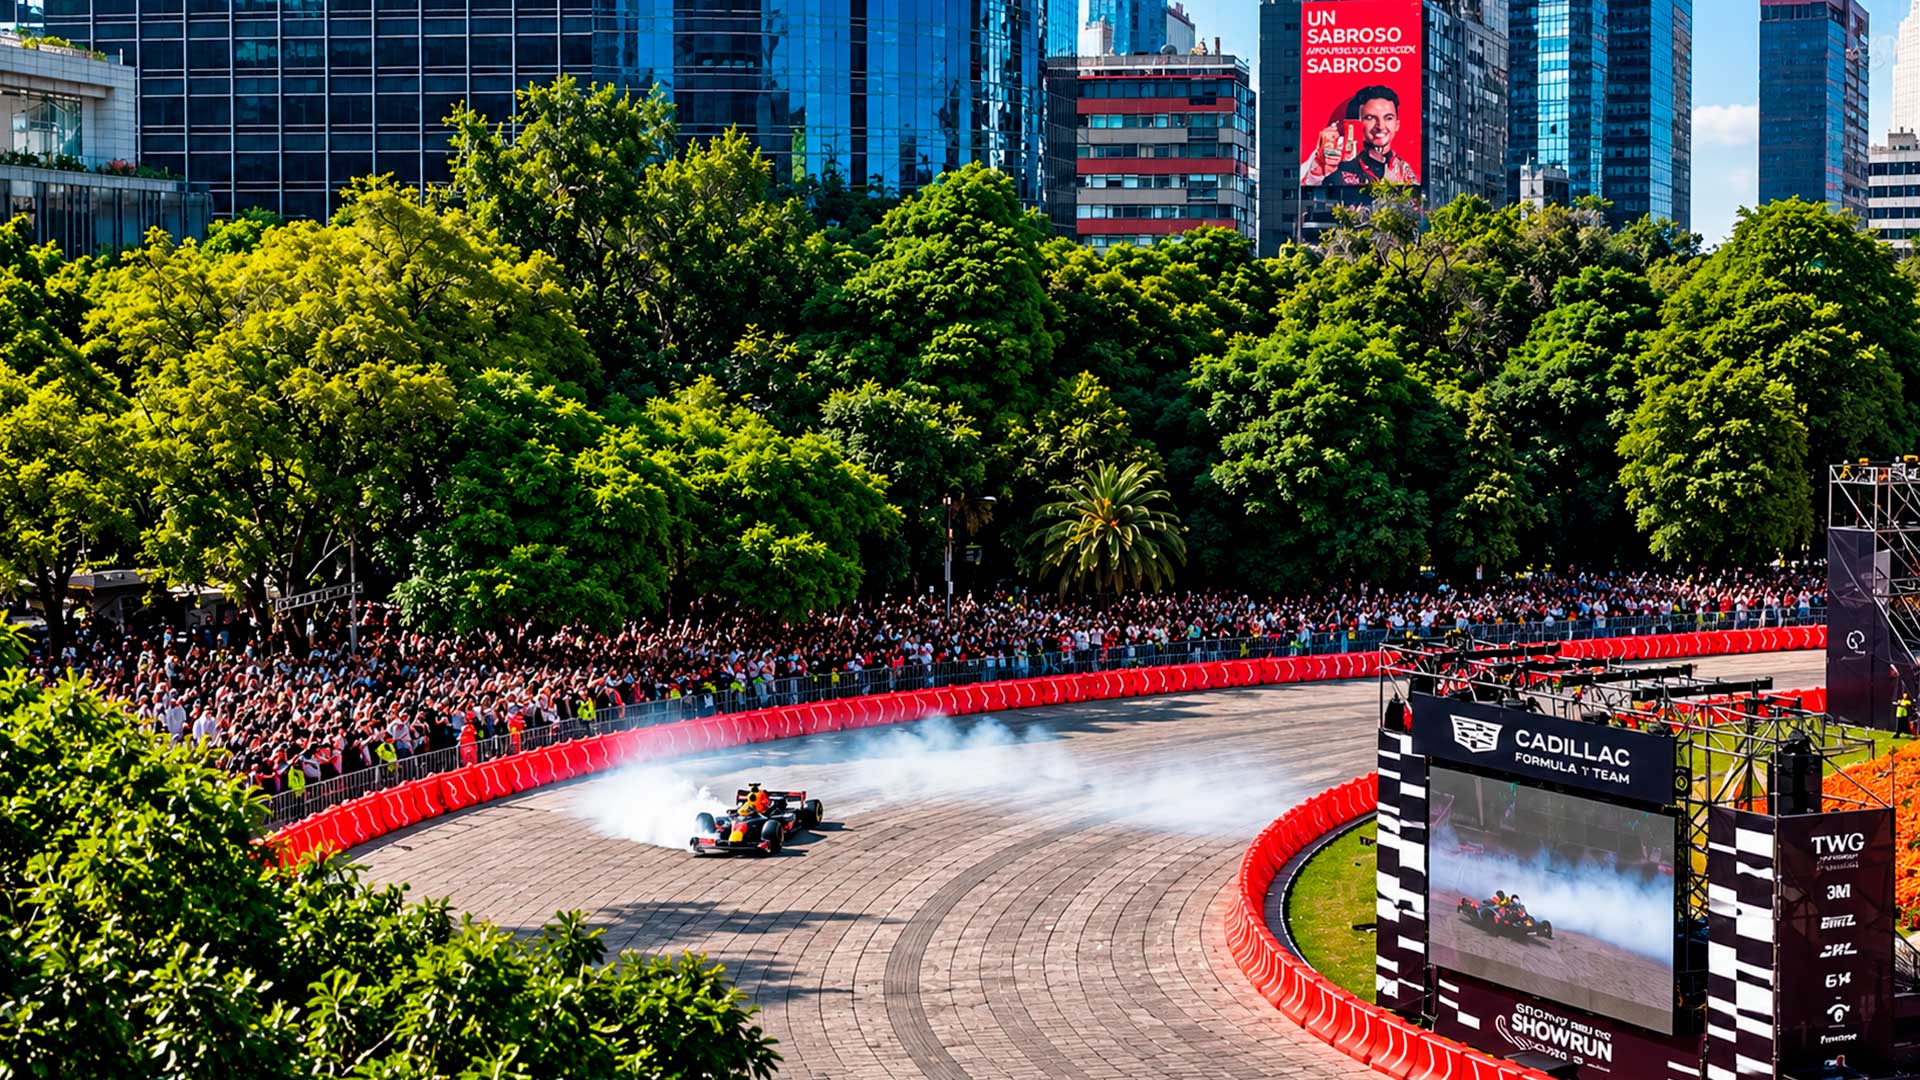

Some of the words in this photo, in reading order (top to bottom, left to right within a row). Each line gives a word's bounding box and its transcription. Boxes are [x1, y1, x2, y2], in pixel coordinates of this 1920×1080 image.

[1308, 10, 1336, 26] UN
[1307, 27, 1402, 44] SABROSO
[1307, 57, 1402, 73] SABROSO
[1515, 729, 1630, 767] CADILLAC
[1515, 752, 1577, 774] FORMULA
[1592, 768, 1630, 784] TEAM
[1811, 833, 1864, 854] TWG
[1827, 884, 1851, 900] 3M
[1511, 1013, 1612, 1062] SHOWRUN
